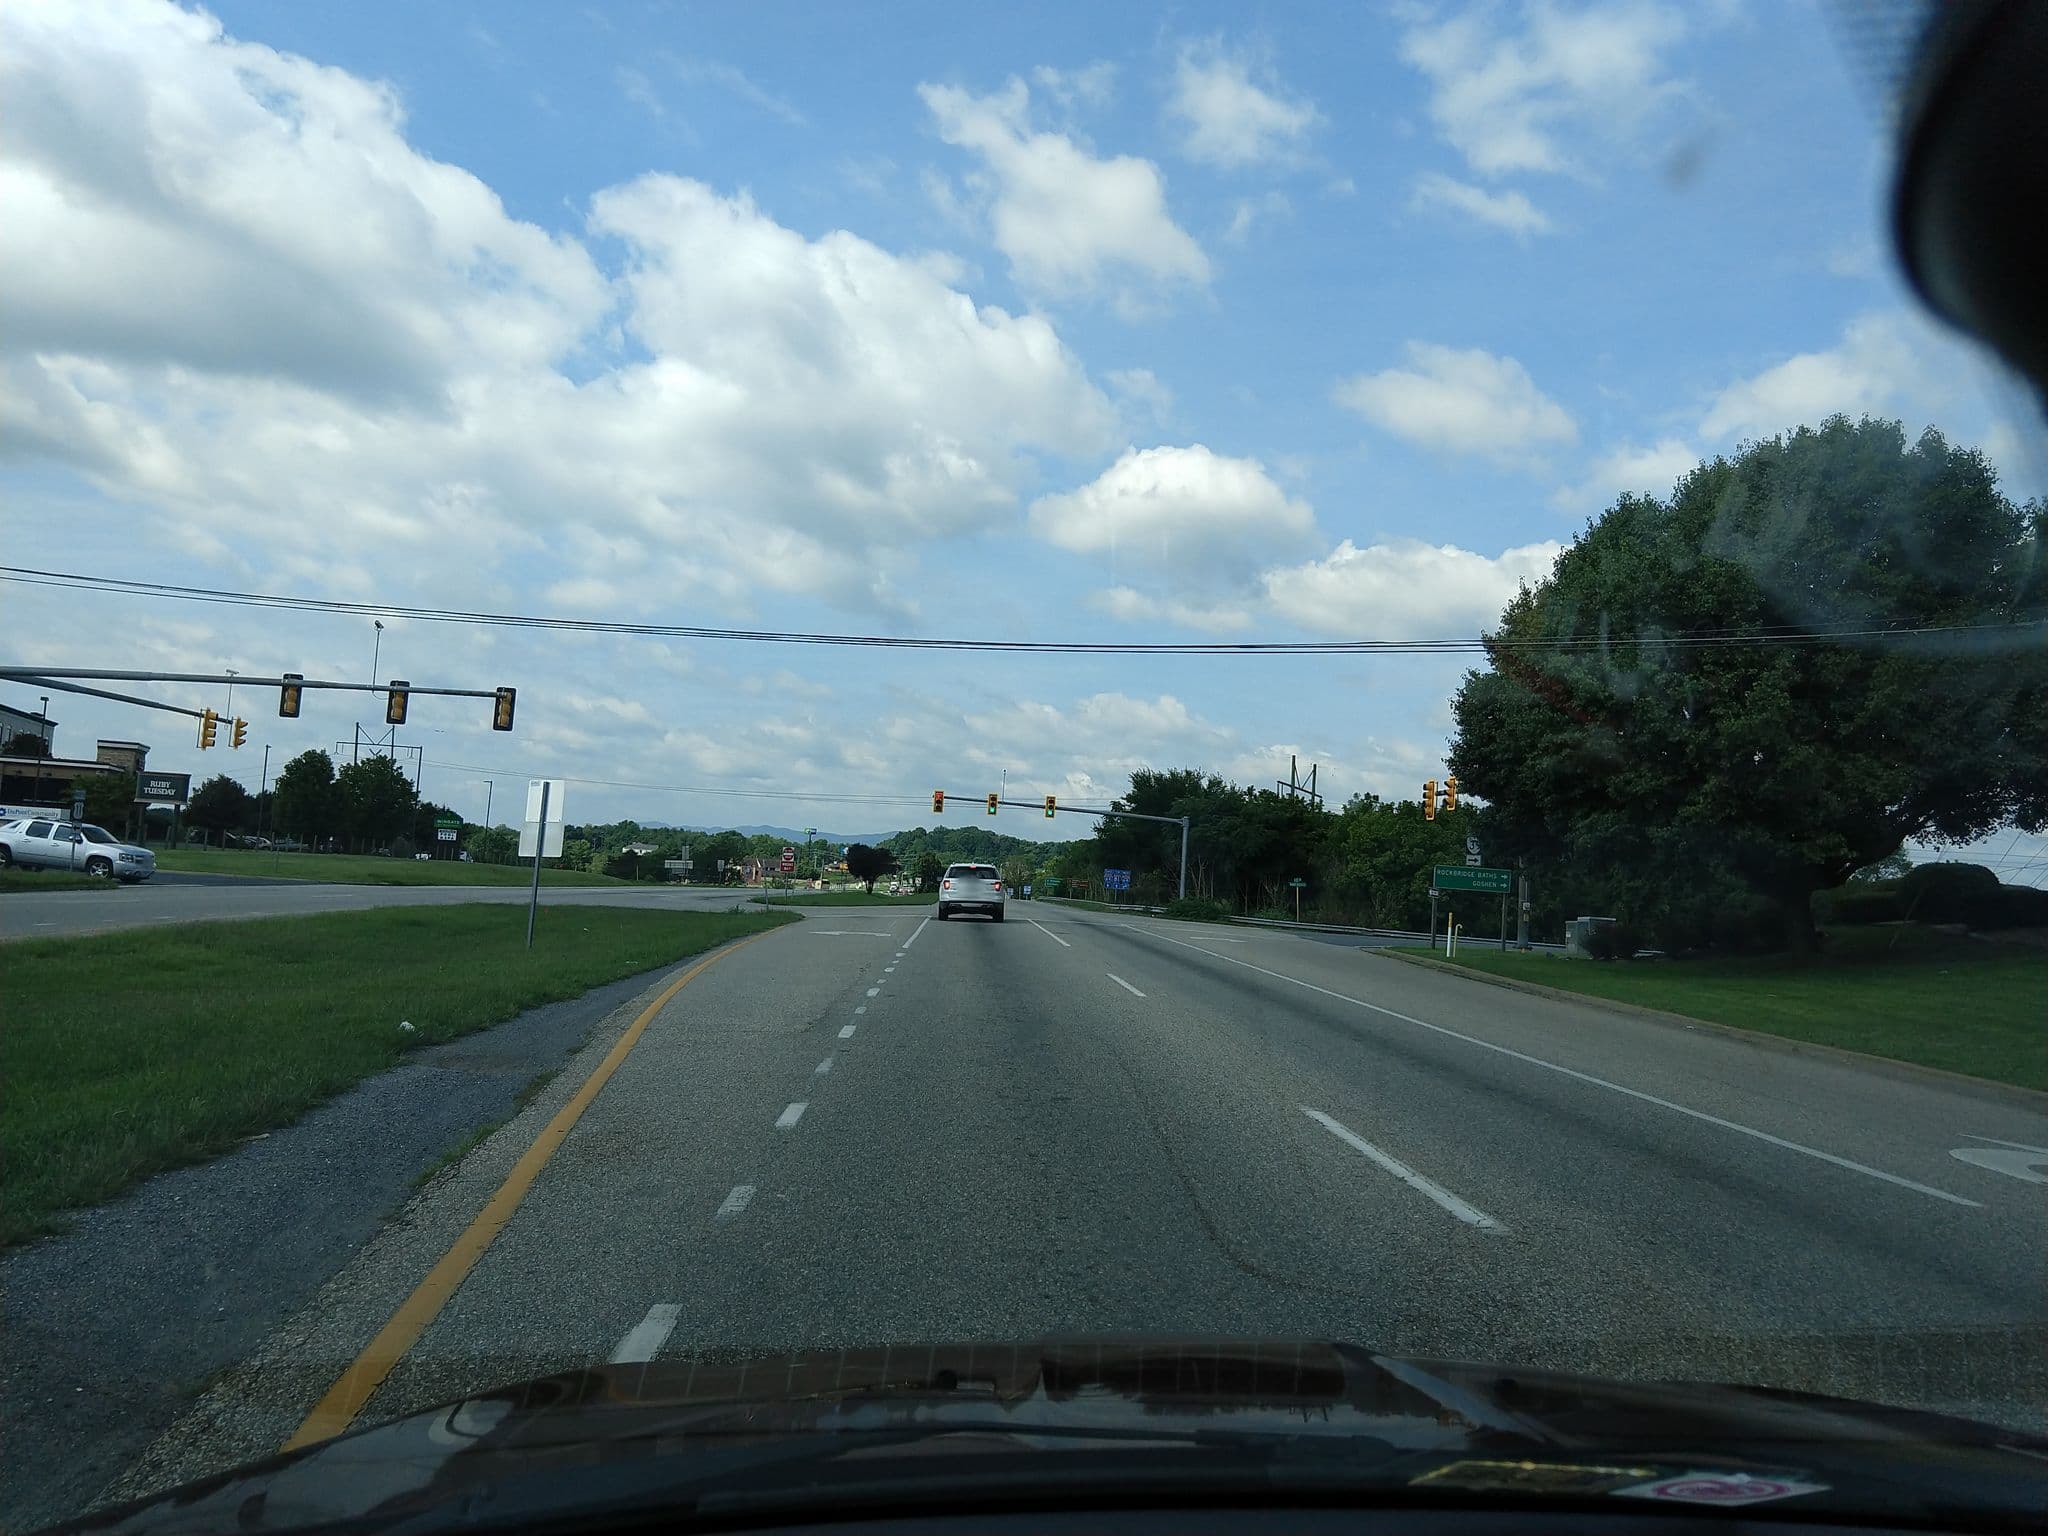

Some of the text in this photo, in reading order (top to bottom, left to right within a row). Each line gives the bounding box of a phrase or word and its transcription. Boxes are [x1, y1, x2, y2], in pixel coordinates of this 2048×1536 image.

[150, 780, 171, 788] RUBY
[144, 787, 176, 796] TUESDAY
[1438, 869, 1475, 877] ROCKBRIDGE
[1472, 880, 1497, 888] GOSHEN
